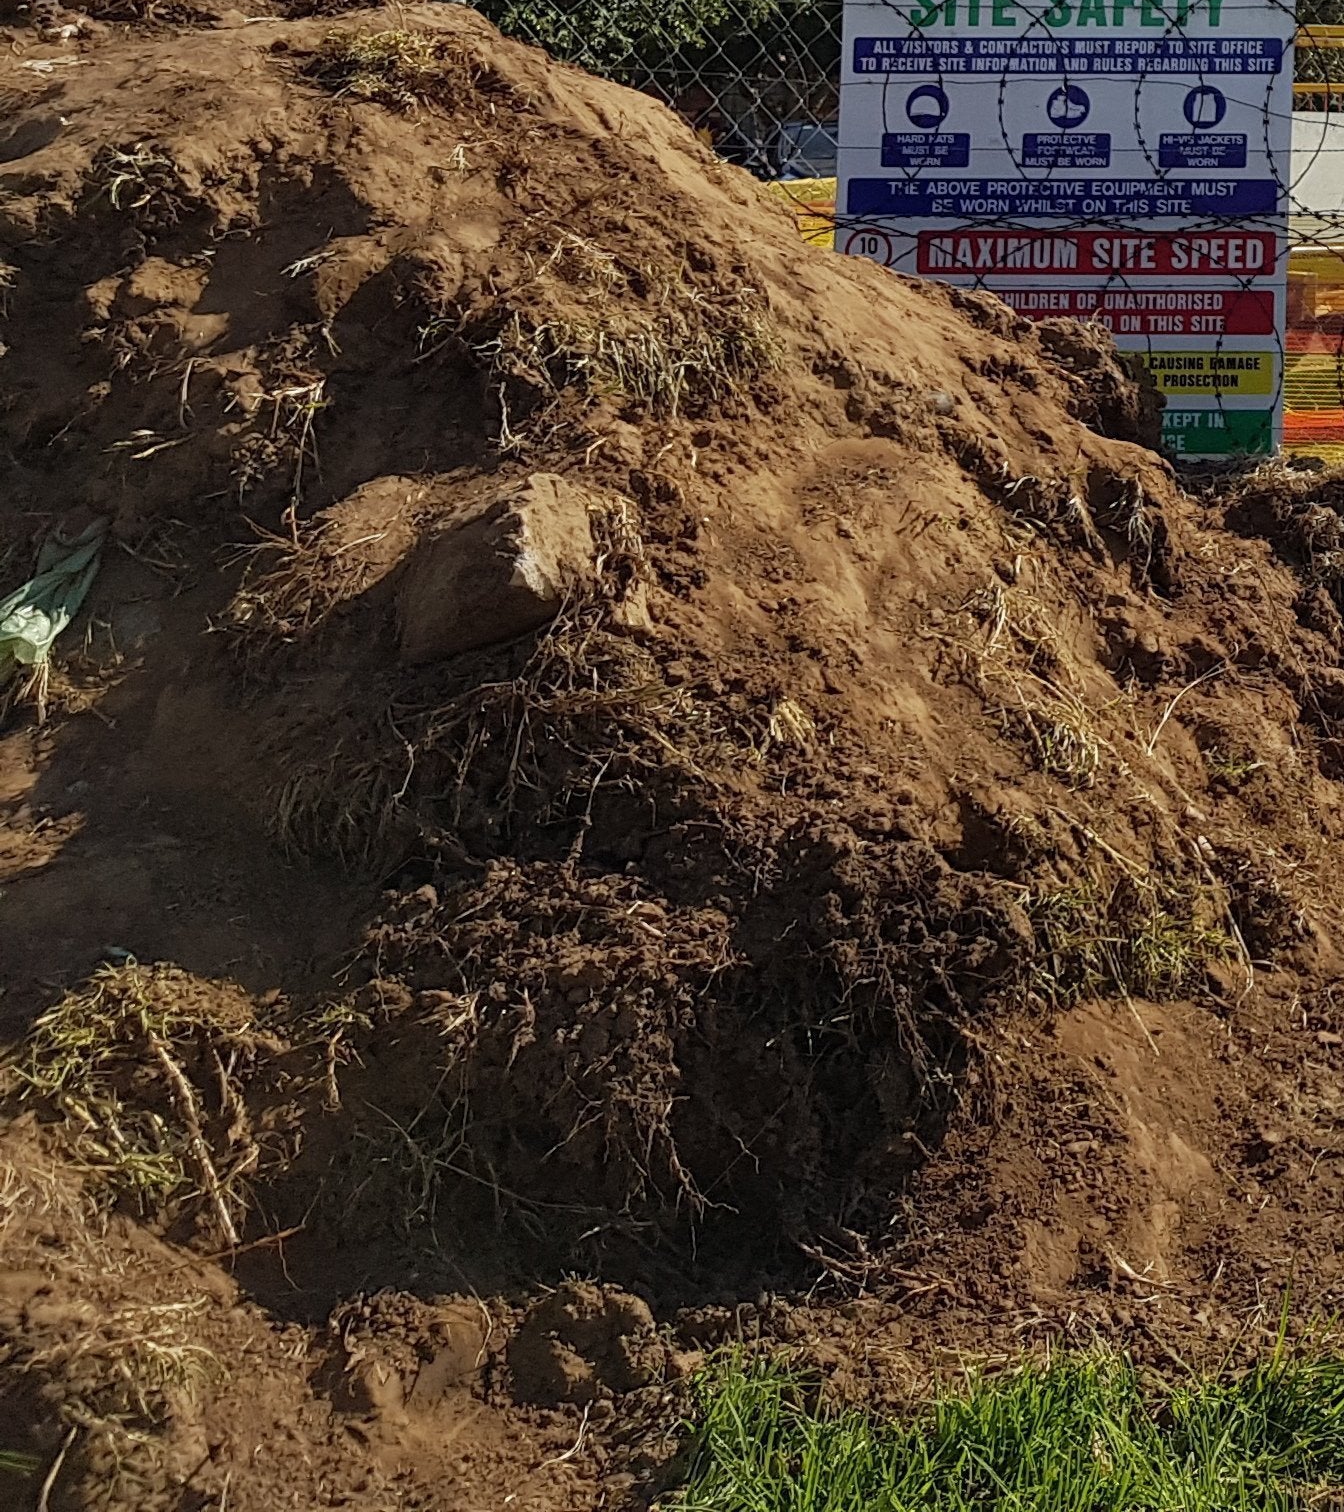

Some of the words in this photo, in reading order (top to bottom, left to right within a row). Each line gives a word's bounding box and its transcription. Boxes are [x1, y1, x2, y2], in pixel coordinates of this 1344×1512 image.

[873, 41, 896, 54] ALL
[901, 40, 959, 54] VISITORS
[964, 40, 974, 54] &
[980, 40, 1069, 54] CONTRACTORS
[1075, 40, 1110, 54] MUST
[1168, 40, 1183, 54] TO
[1188, 40, 1216, 54] SITE
[1222, 40, 1264, 54] OFFICE
[860, 57, 877, 71] TO
[882, 57, 933, 71] RECEIVE
[938, 57, 966, 71] SITE
[972, 57, 1056, 71] INFORMATION
[1063, 57, 1088, 71] AND
[1093, 57, 1132, 71] RULES
[1138, 57, 1209, 72] REGARDING
[1214, 57, 1242, 72] THIS
[1247, 58, 1275, 72] SITE
[897, 135, 925, 144] HARD
[1198, 135, 1243, 145] JACKETS
[1025, 157, 1055, 166] MUST
[1057, 157, 1072, 166] BE
[1075, 157, 1107, 166] WORN
[1187, 157, 1219, 166] WORN
[887, 182, 919, 195] THE
[926, 182, 980, 195] ABOVE
[987, 182, 1084, 196] PROTECTIVE
[1092, 182, 1186, 196] EQUIPMENT
[1191, 182, 1237, 196] MUST
[960, 199, 1009, 213] WORN
[1016, 199, 1076, 213] WHILST
[1082, 199, 1106, 213] ON
[1113, 199, 1149, 213] THIS
[1156, 199, 1192, 213] SITE
[861, 237, 878, 254] 10
[928, 238, 1077, 268] MAXIMUM
[1092, 238, 1156, 268] SITE
[1170, 239, 1264, 269] SPEED
[1103, 293, 1223, 310] UNAUTHORISED
[1120, 315, 1141, 332] ON
[1149, 315, 1184, 332] THIS
[1190, 316, 1225, 332] SITE
[1150, 357, 1204, 370] CAUSING
[1210, 357, 1260, 370] DAMAGE
[1208, 413, 1224, 428] IN
